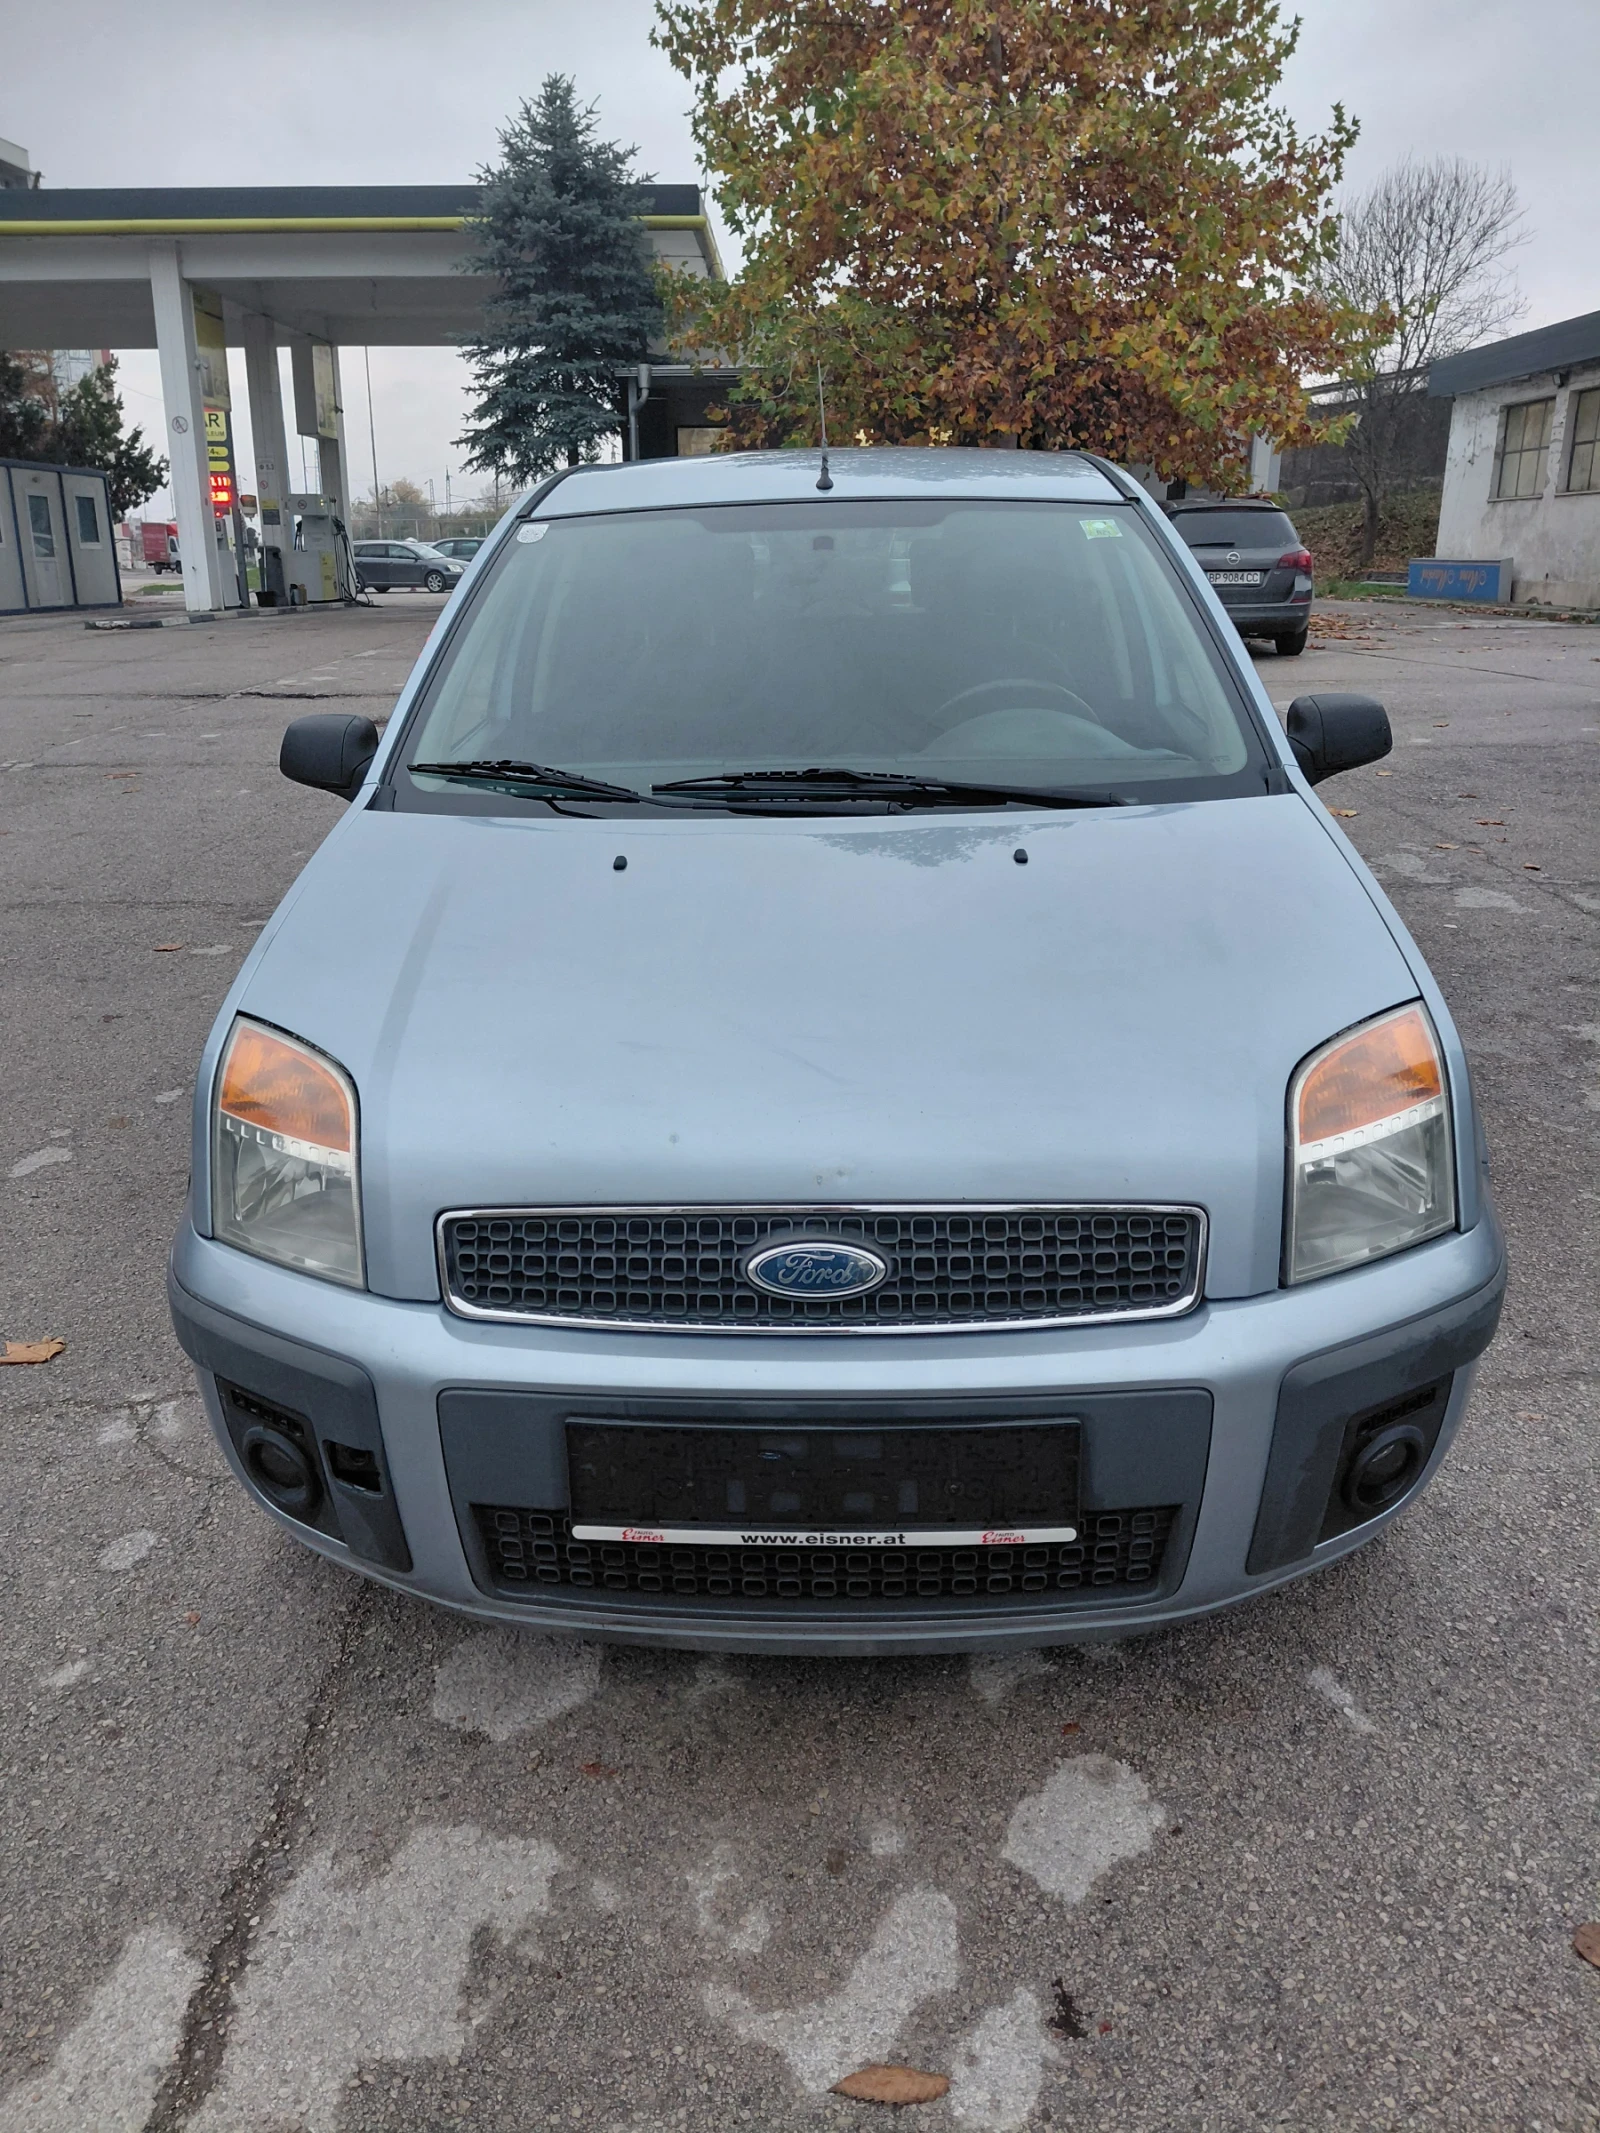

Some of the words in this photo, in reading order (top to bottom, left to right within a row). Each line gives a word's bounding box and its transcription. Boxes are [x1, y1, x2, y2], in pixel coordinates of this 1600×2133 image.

[1222, 572, 1245, 583] 9084
[1246, 572, 1259, 582] CC
[778, 1253, 854, 1284] Ford
[741, 1533, 906, 1545] www.eisner.at
